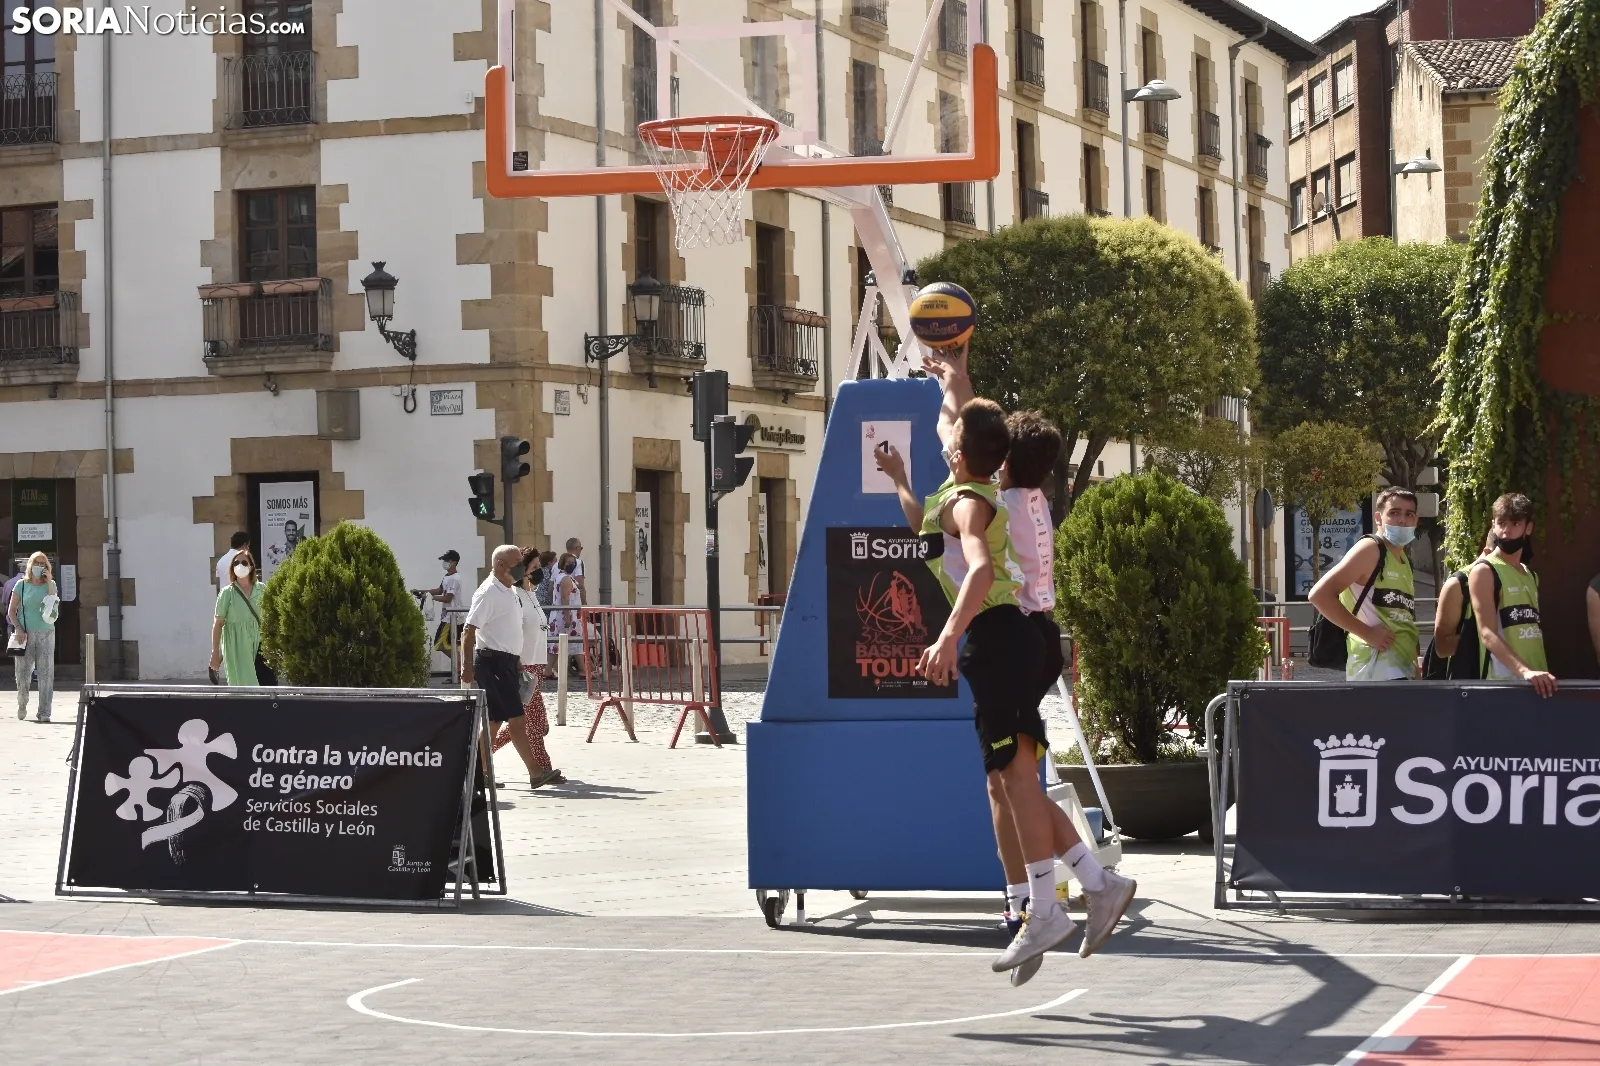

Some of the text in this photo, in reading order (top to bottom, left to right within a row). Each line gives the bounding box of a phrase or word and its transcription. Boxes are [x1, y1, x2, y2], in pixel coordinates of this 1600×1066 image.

[21, 489, 38, 501] ATM
[267, 496, 308, 509] SOMOS MÁS
[1321, 526, 1357, 534] NATACIÓN
[252, 743, 443, 768] Contra la violencia
[1453, 755, 1600, 773] AYUNTAMIENT
[248, 767, 353, 793] de género
[245, 798, 378, 816] Servicios Sociales
[243, 816, 376, 838] de Castilla y León
